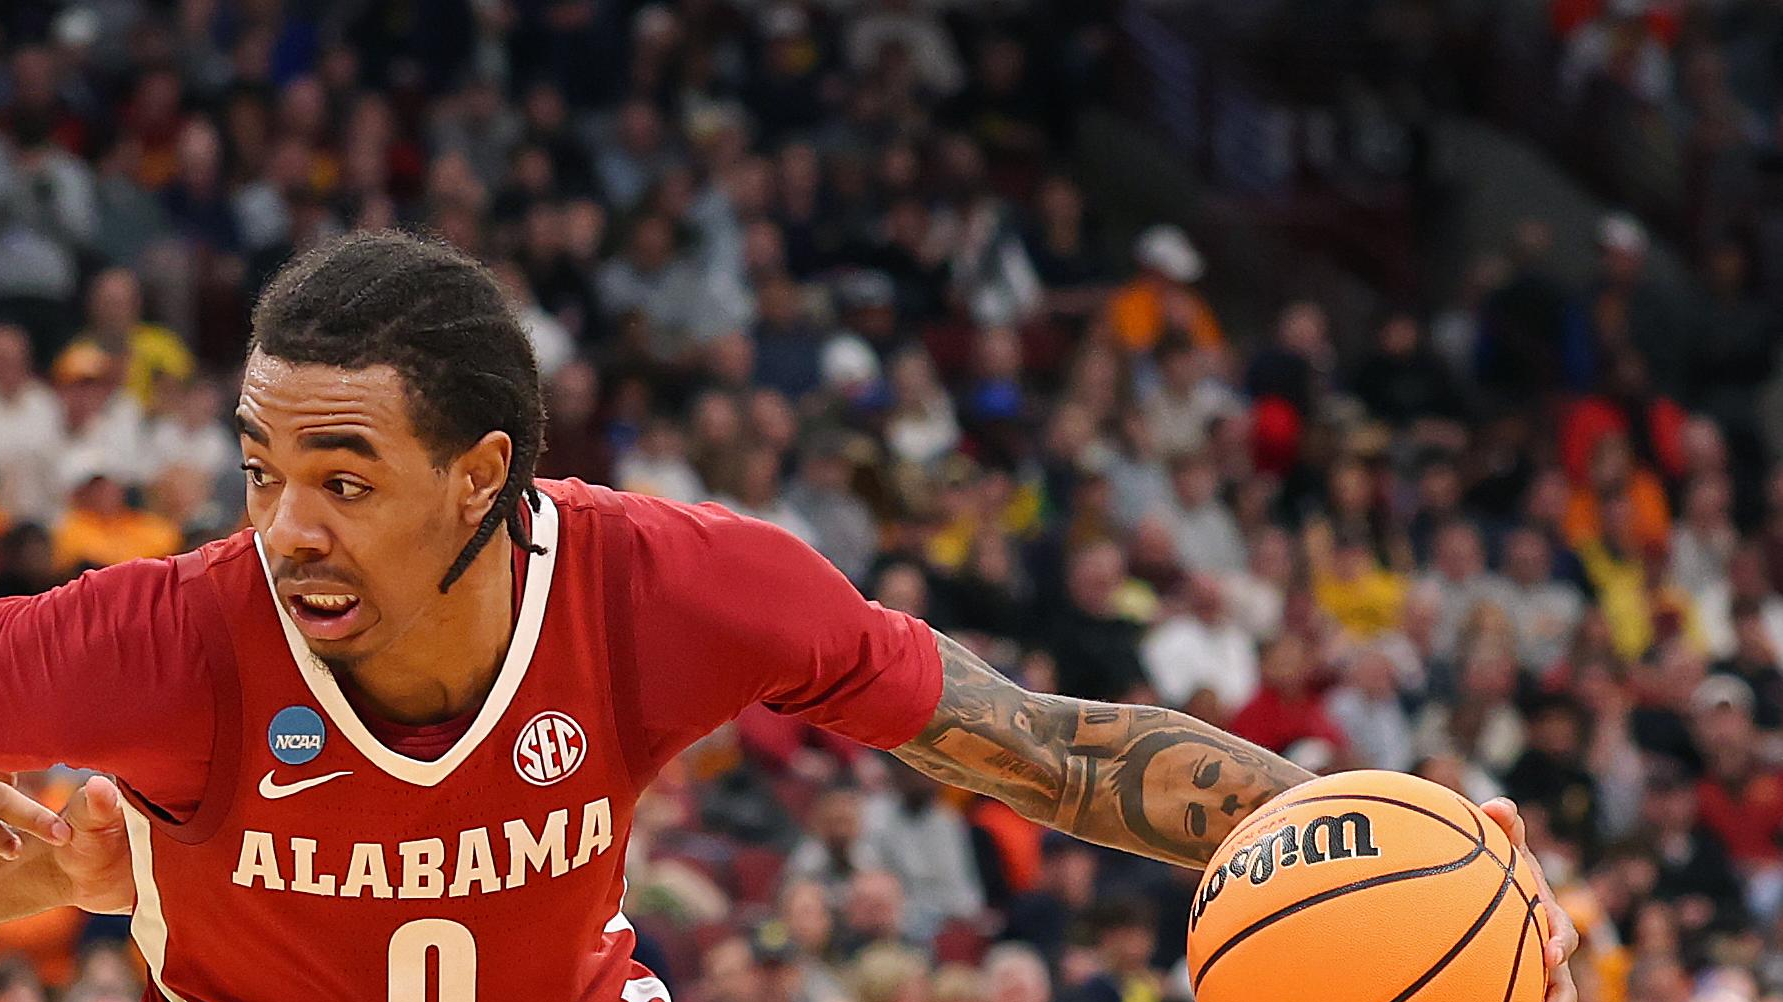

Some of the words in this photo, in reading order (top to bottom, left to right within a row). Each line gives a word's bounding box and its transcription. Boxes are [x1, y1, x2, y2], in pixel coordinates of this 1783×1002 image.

[275, 734, 321, 750] NCAA
[518, 716, 580, 781] SEC
[232, 797, 614, 900] ALABAMA
